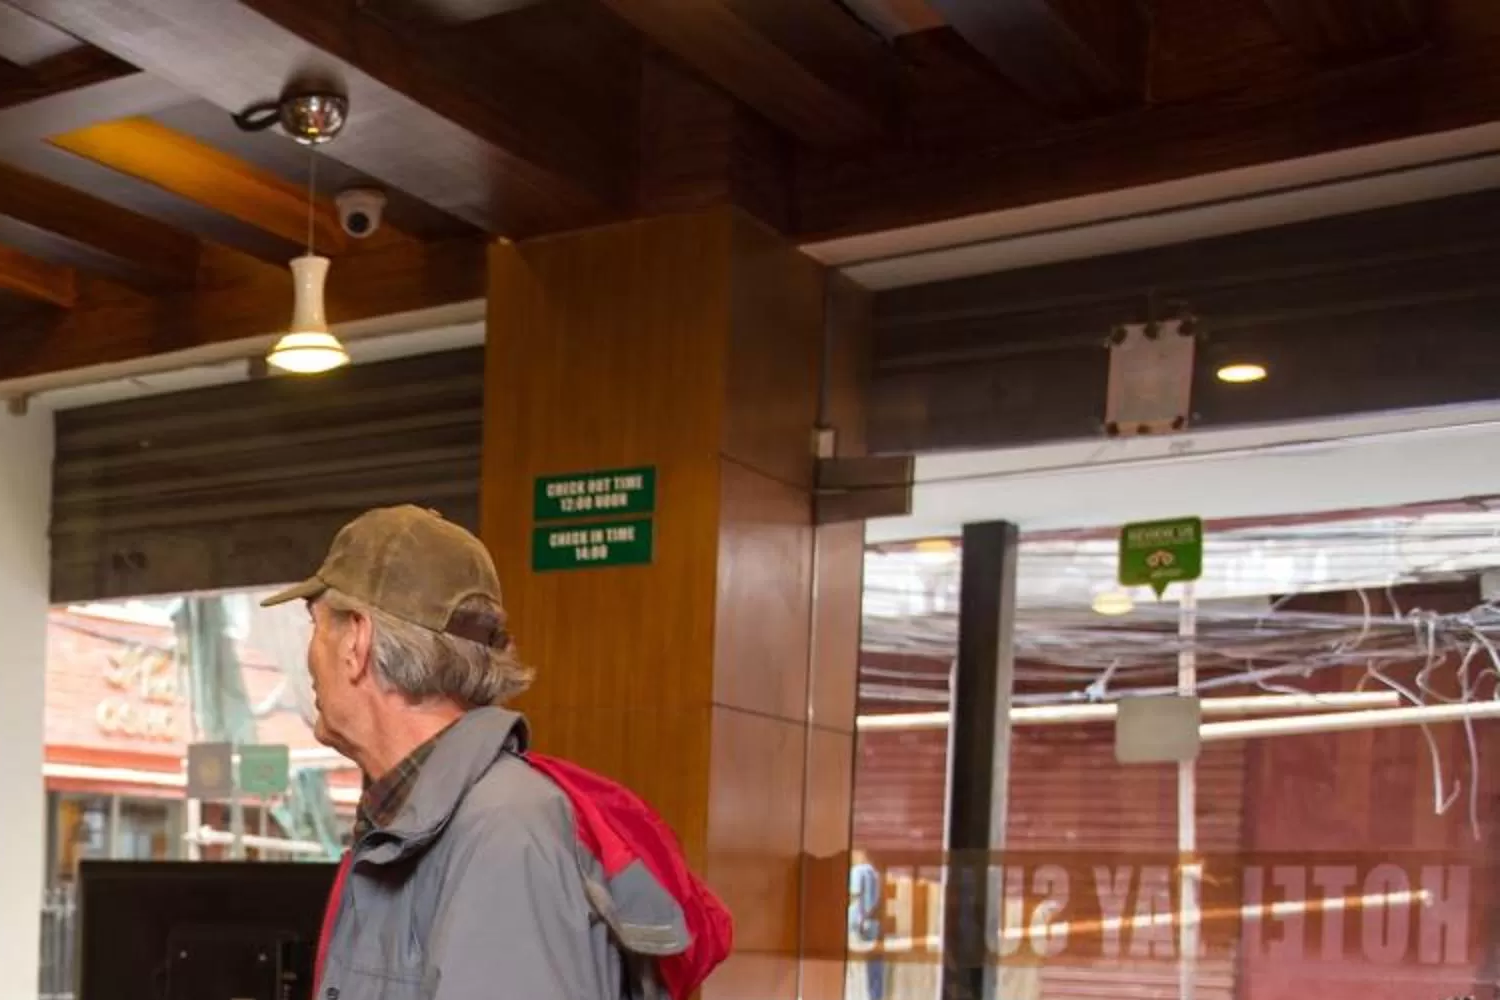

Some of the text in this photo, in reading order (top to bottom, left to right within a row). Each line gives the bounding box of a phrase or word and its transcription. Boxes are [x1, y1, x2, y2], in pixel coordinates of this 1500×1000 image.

[546, 475, 643, 496] CHECK OUT TIME
[561, 497, 592, 511] 12:00
[549, 526, 635, 547] CHECK IN TIME
